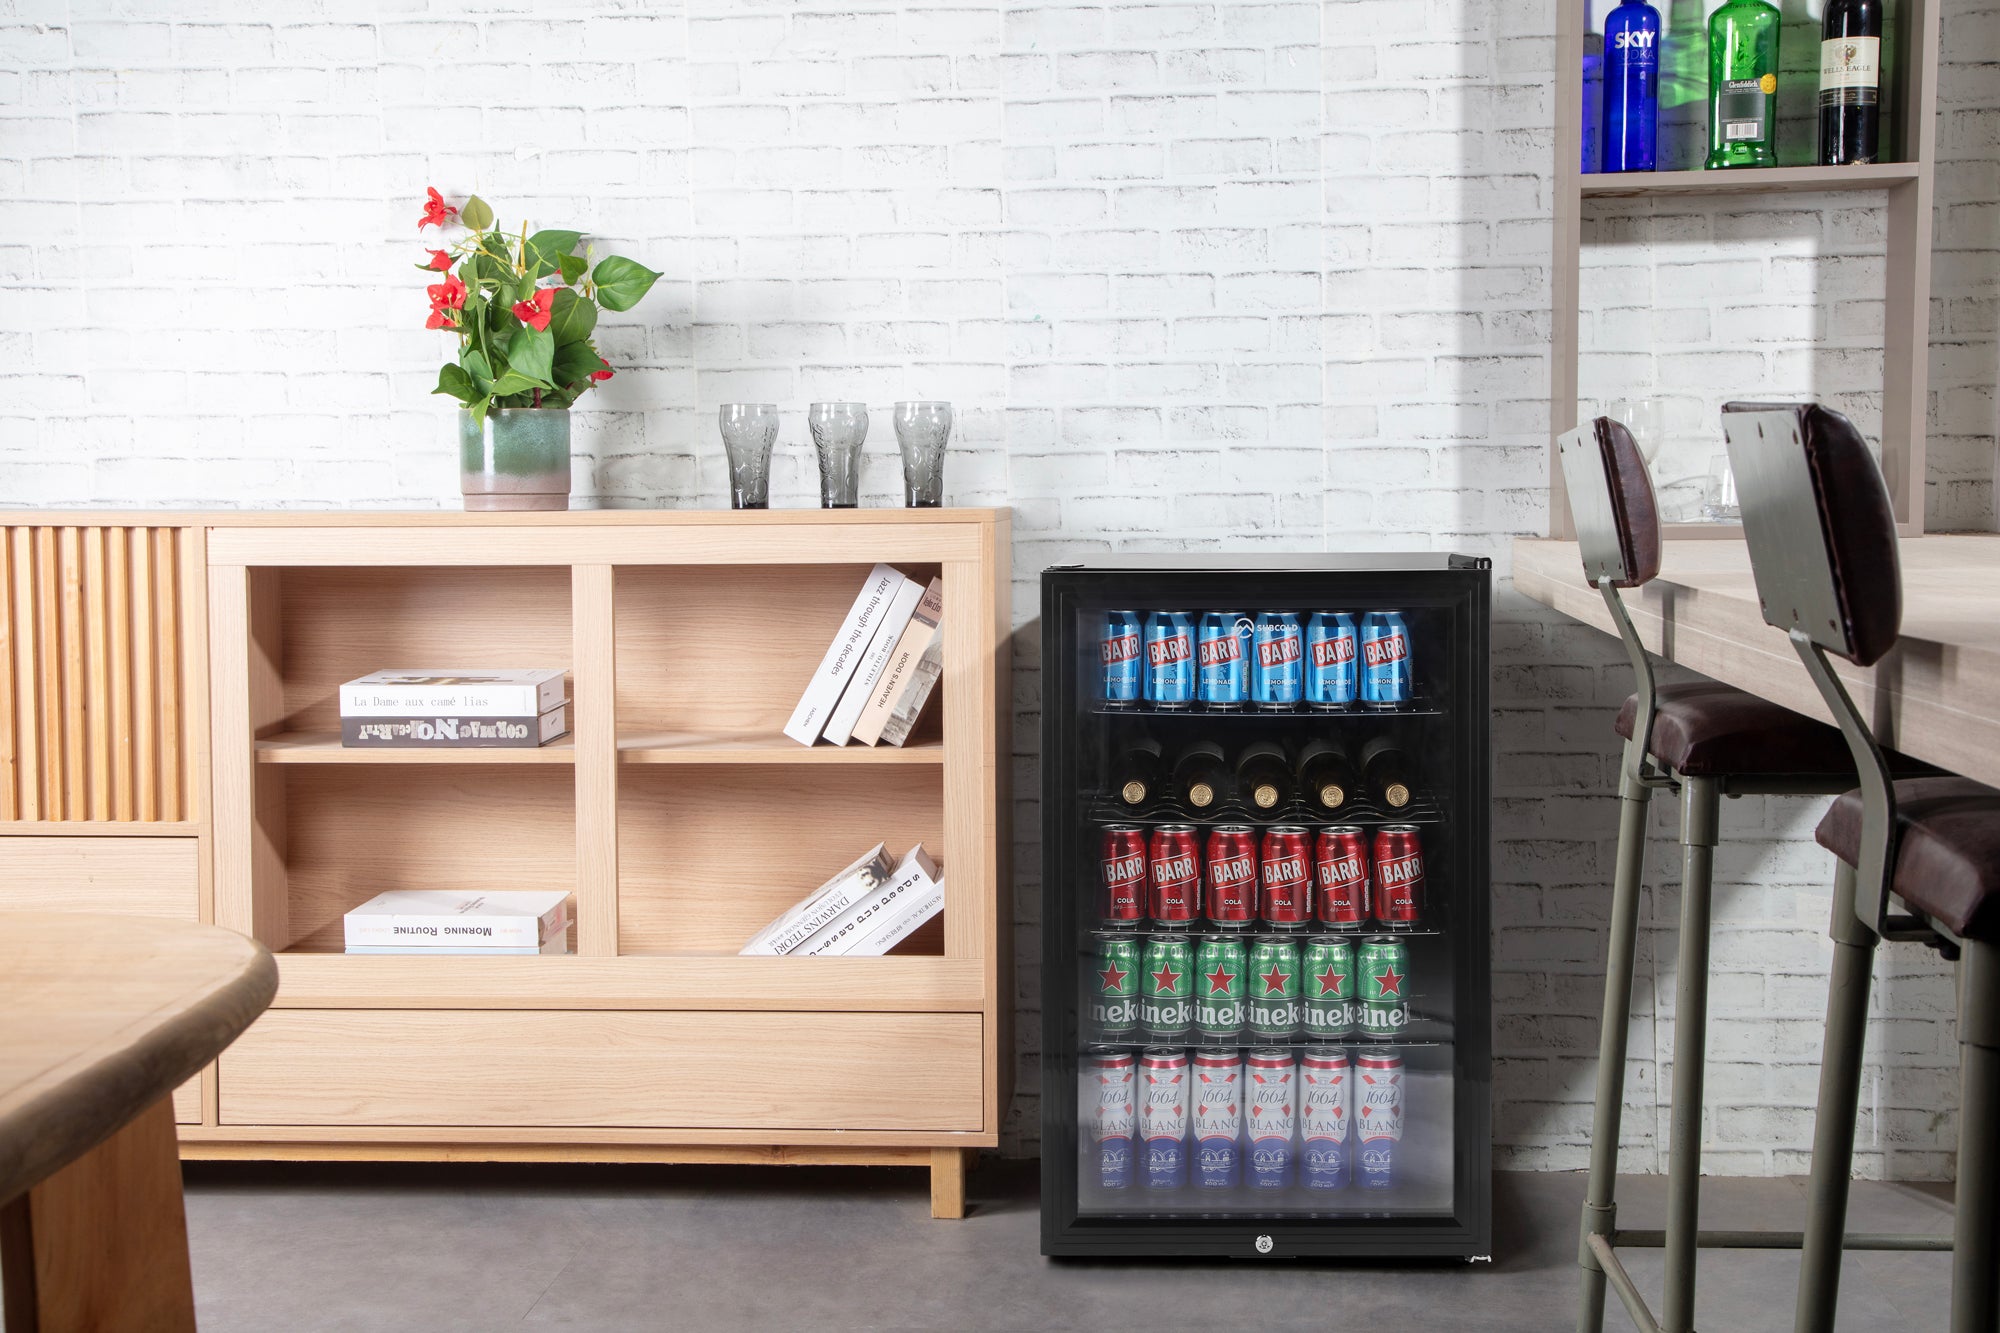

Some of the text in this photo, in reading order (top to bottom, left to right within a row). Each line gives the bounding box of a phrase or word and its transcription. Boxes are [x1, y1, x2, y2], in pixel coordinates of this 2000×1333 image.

[1615, 30, 1655, 48] SKYY
[830, 577, 891, 676] Jazz through the decades
[1257, 624, 1298, 632] SUBCOLD
[881, 634, 894, 653] BOOK
[1102, 637, 1139, 661] BARR
[1150, 638, 1188, 662] BARR
[1201, 638, 1238, 662] BARR
[1261, 639, 1299, 664] BARR
[1315, 639, 1353, 664] BARR
[1366, 637, 1404, 662] BARR
[876, 652, 910, 708] HEAVEN'S DOOR
[354, 696, 367, 706] La
[373, 696, 398, 706] Dame
[431, 696, 455, 706] camé
[464, 695, 488, 706] lias
[803, 706, 817, 728] TASCHEN
[418, 718, 458, 740] NO
[460, 720, 528, 738] CORMAC
[1106, 857, 1143, 882] BARR
[1156, 858, 1193, 882] BARR
[1213, 858, 1251, 883] BARR
[1265, 859, 1302, 883] BARR
[1321, 859, 1359, 884] BARR
[1383, 858, 1420, 883] BARR
[881, 873, 920, 905] speed
[856, 903, 880, 923] and
[393, 926, 437, 935] ROUTINE
[444, 926, 492, 936] MORNING
[774, 896, 850, 954] DARWINS TEORI
[1100, 1089, 1129, 1104] 1664
[1148, 1090, 1178, 1104] 1664
[1201, 1089, 1233, 1104] 1664
[1256, 1089, 1288, 1104] 1664
[1307, 1090, 1339, 1105] 1664
[1366, 1089, 1397, 1105] 1664
[1092, 1118, 1135, 1130] BLANC
[1142, 1118, 1185, 1130] BLANC
[1195, 1118, 1238, 1130] BLANC
[1250, 1118, 1293, 1130] BLANC
[1302, 1118, 1345, 1131] BLANC
[1360, 1118, 1402, 1131] BLANC
